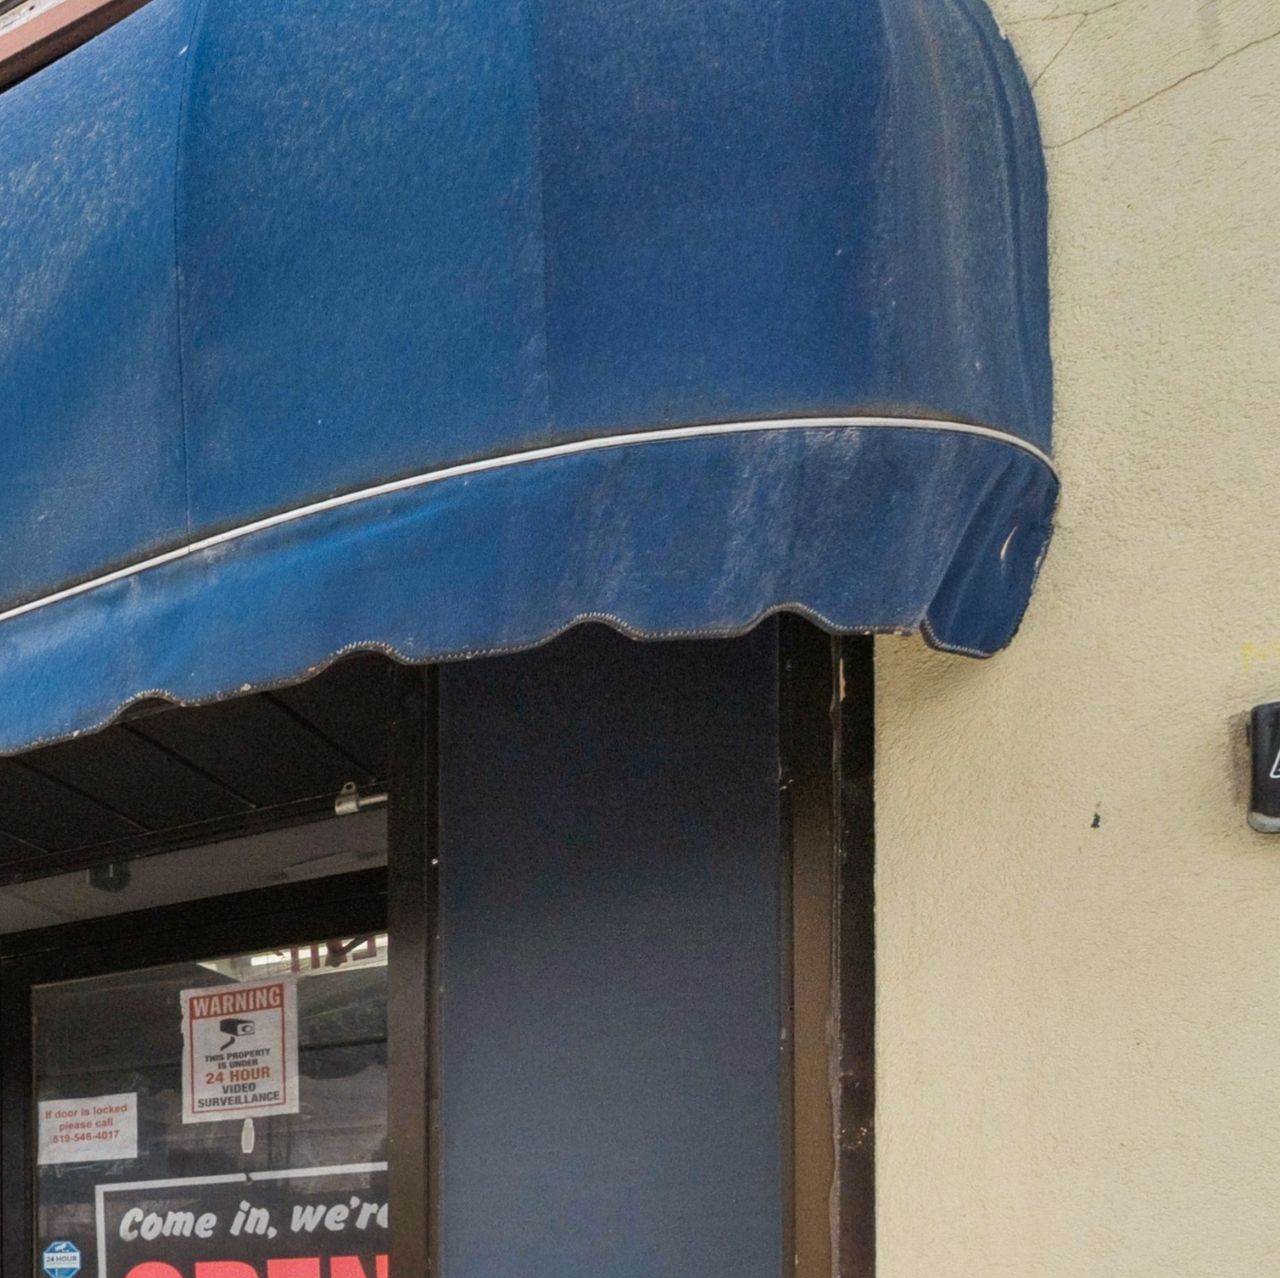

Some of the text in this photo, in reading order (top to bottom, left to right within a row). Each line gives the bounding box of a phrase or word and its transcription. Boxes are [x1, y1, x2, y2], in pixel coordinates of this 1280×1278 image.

[192, 985, 281, 1018] WARNING
[205, 1047, 272, 1063] THIS PROPERTY
[217, 1058, 259, 1070] IS UNDER
[205, 1065, 271, 1085] 24 HOUR
[221, 1082, 257, 1095] VIDEO
[197, 1090, 281, 1109] SURVEILLANCE
[45, 1103, 128, 1119] If door is locked
[58, 1117, 114, 1133] please call
[119, 1206, 218, 1242] Come
[229, 1199, 278, 1239] in,
